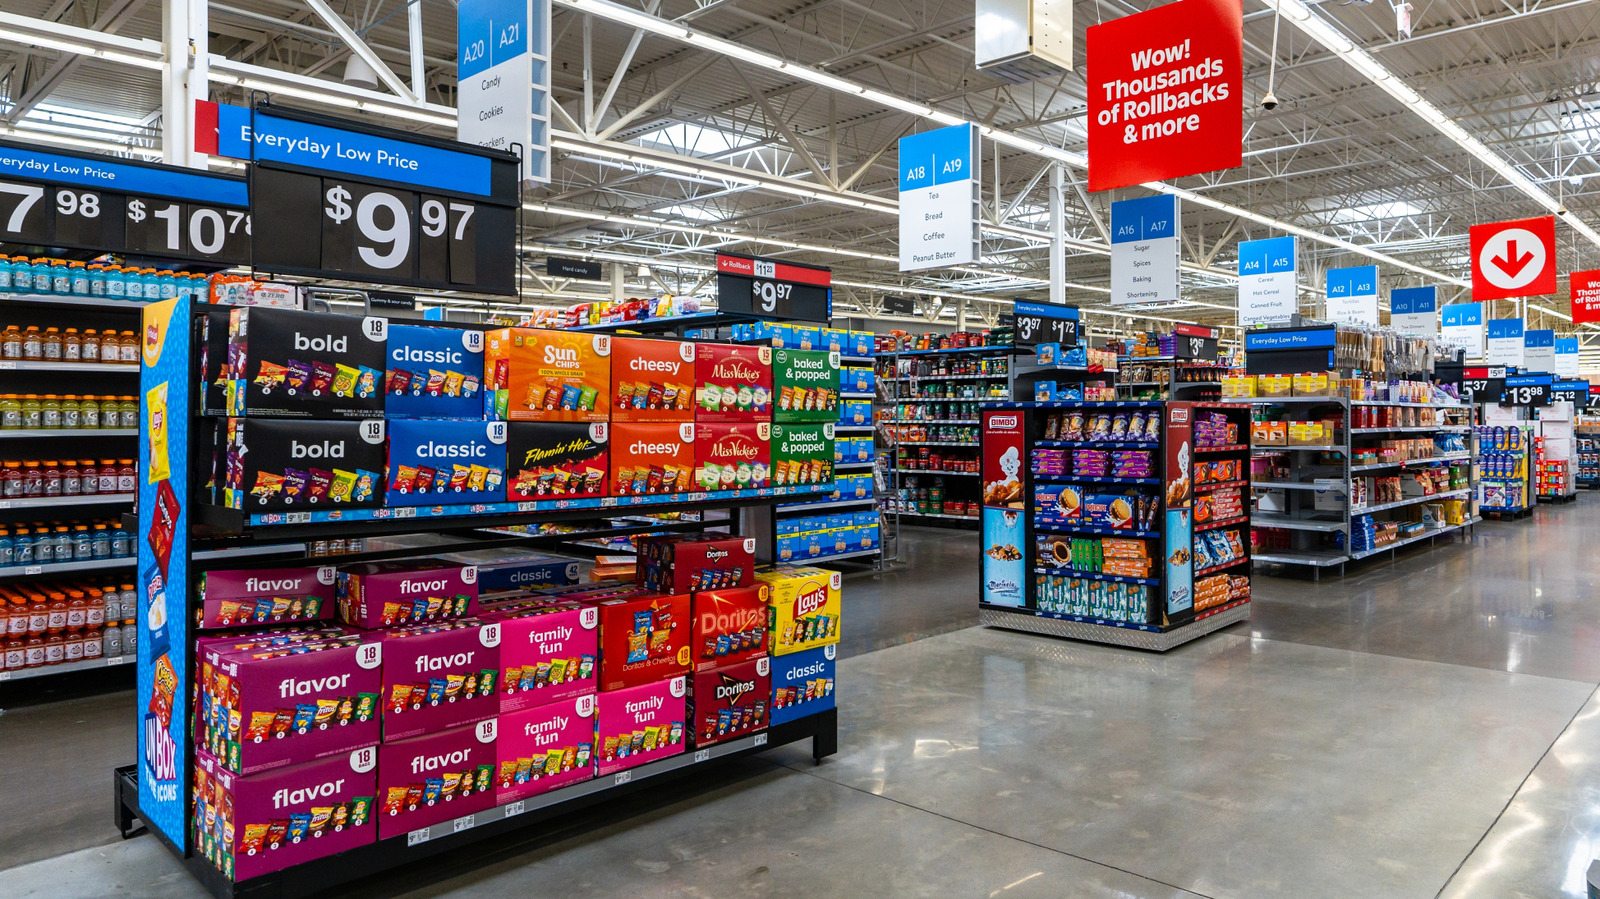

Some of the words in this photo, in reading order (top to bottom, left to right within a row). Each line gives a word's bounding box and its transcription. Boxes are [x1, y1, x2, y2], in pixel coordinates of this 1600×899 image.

[463, 39, 484, 64] A20
[499, 23, 519, 48] A21
[1131, 39, 1190, 71] Wow!
[481, 75, 502, 91] Candy
[1102, 57, 1223, 101] Thousands
[1098, 103, 1120, 126] of
[1123, 83, 1229, 121] Rollbacks
[479, 106, 503, 122] Cookies
[1123, 124, 1138, 144] &
[1142, 113, 1200, 141] more
[241, 125, 331, 159] Everyday
[336, 141, 372, 166] Low
[376, 148, 418, 172] Price
[54, 162, 80, 174] Low
[84, 166, 115, 180] Price
[907, 167, 925, 181] A18
[942, 159, 962, 174] A19
[929, 192, 939, 200] Tea
[925, 211, 942, 221] Bread
[1118, 225, 1135, 236] A16
[1150, 221, 1167, 232] A17
[923, 232, 945, 241] Coffee
[1134, 244, 1150, 252] Sugar
[913, 254, 934, 263] Peanut
[936, 251, 956, 260] Butter
[574, 266, 588, 274] candy
[729, 260, 751, 270] Rollback
[1133, 260, 1151, 268] Spices
[1244, 261, 1260, 270] A14
[1273, 258, 1289, 267] A15
[1133, 275, 1152, 284] Baking
[1127, 291, 1158, 299] Shortening
[1262, 313, 1290, 321] Vegetables
[370, 320, 382, 332] 18
[295, 332, 347, 353] bold
[469, 334, 479, 344] 18
[598, 338, 607, 347] 18
[392, 346, 462, 364] classic
[544, 345, 576, 364] Sun
[684, 345, 692, 354] 18
[763, 350, 769, 358] 15
[630, 356, 680, 375] cheesy
[794, 358, 823, 369] baked
[786, 368, 793, 378] &
[795, 370, 830, 381] popped
[367, 423, 380, 434] 18
[493, 424, 503, 435] 18
[595, 425, 603, 435] 18
[684, 426, 692, 435] 18
[761, 425, 768, 434] 15
[789, 431, 817, 441] baked
[292, 441, 344, 458] bold
[416, 440, 486, 457] classic
[524, 442, 567, 466] Flamin'
[568, 438, 591, 452] Hot
[629, 440, 680, 457] cheesy
[781, 442, 788, 452] &
[791, 442, 825, 454] popped
[323, 569, 332, 578] 18
[466, 568, 474, 577] 18
[570, 565, 578, 573] 42
[510, 569, 552, 582] classic
[833, 575, 839, 584] 18
[246, 578, 301, 592] flavor
[400, 580, 448, 594] flavor
[761, 588, 767, 596] 18
[798, 588, 825, 616] Lay's
[585, 611, 594, 620] 18
[701, 606, 766, 634] Doritos
[486, 627, 496, 638] 18
[529, 626, 573, 643] family
[364, 647, 376, 659] 18
[539, 641, 562, 655] fun
[681, 649, 688, 659] 18
[415, 651, 475, 673] flavor
[623, 662, 645, 671] Doritos
[652, 656, 676, 665] Cheetos
[761, 660, 767, 669] 18
[786, 661, 825, 680] classic
[279, 673, 350, 698] flavor
[675, 680, 683, 689] 18
[717, 680, 755, 699] Doritos
[581, 698, 590, 709] 18
[625, 696, 664, 713] family
[635, 711, 655, 723] fun
[483, 722, 492, 734] 18
[524, 716, 568, 736] family
[535, 733, 558, 746] fun
[358, 750, 370, 763] 18
[411, 748, 471, 774] flavor
[157, 784, 176, 802] ICONS
[272, 778, 345, 809] flavor
